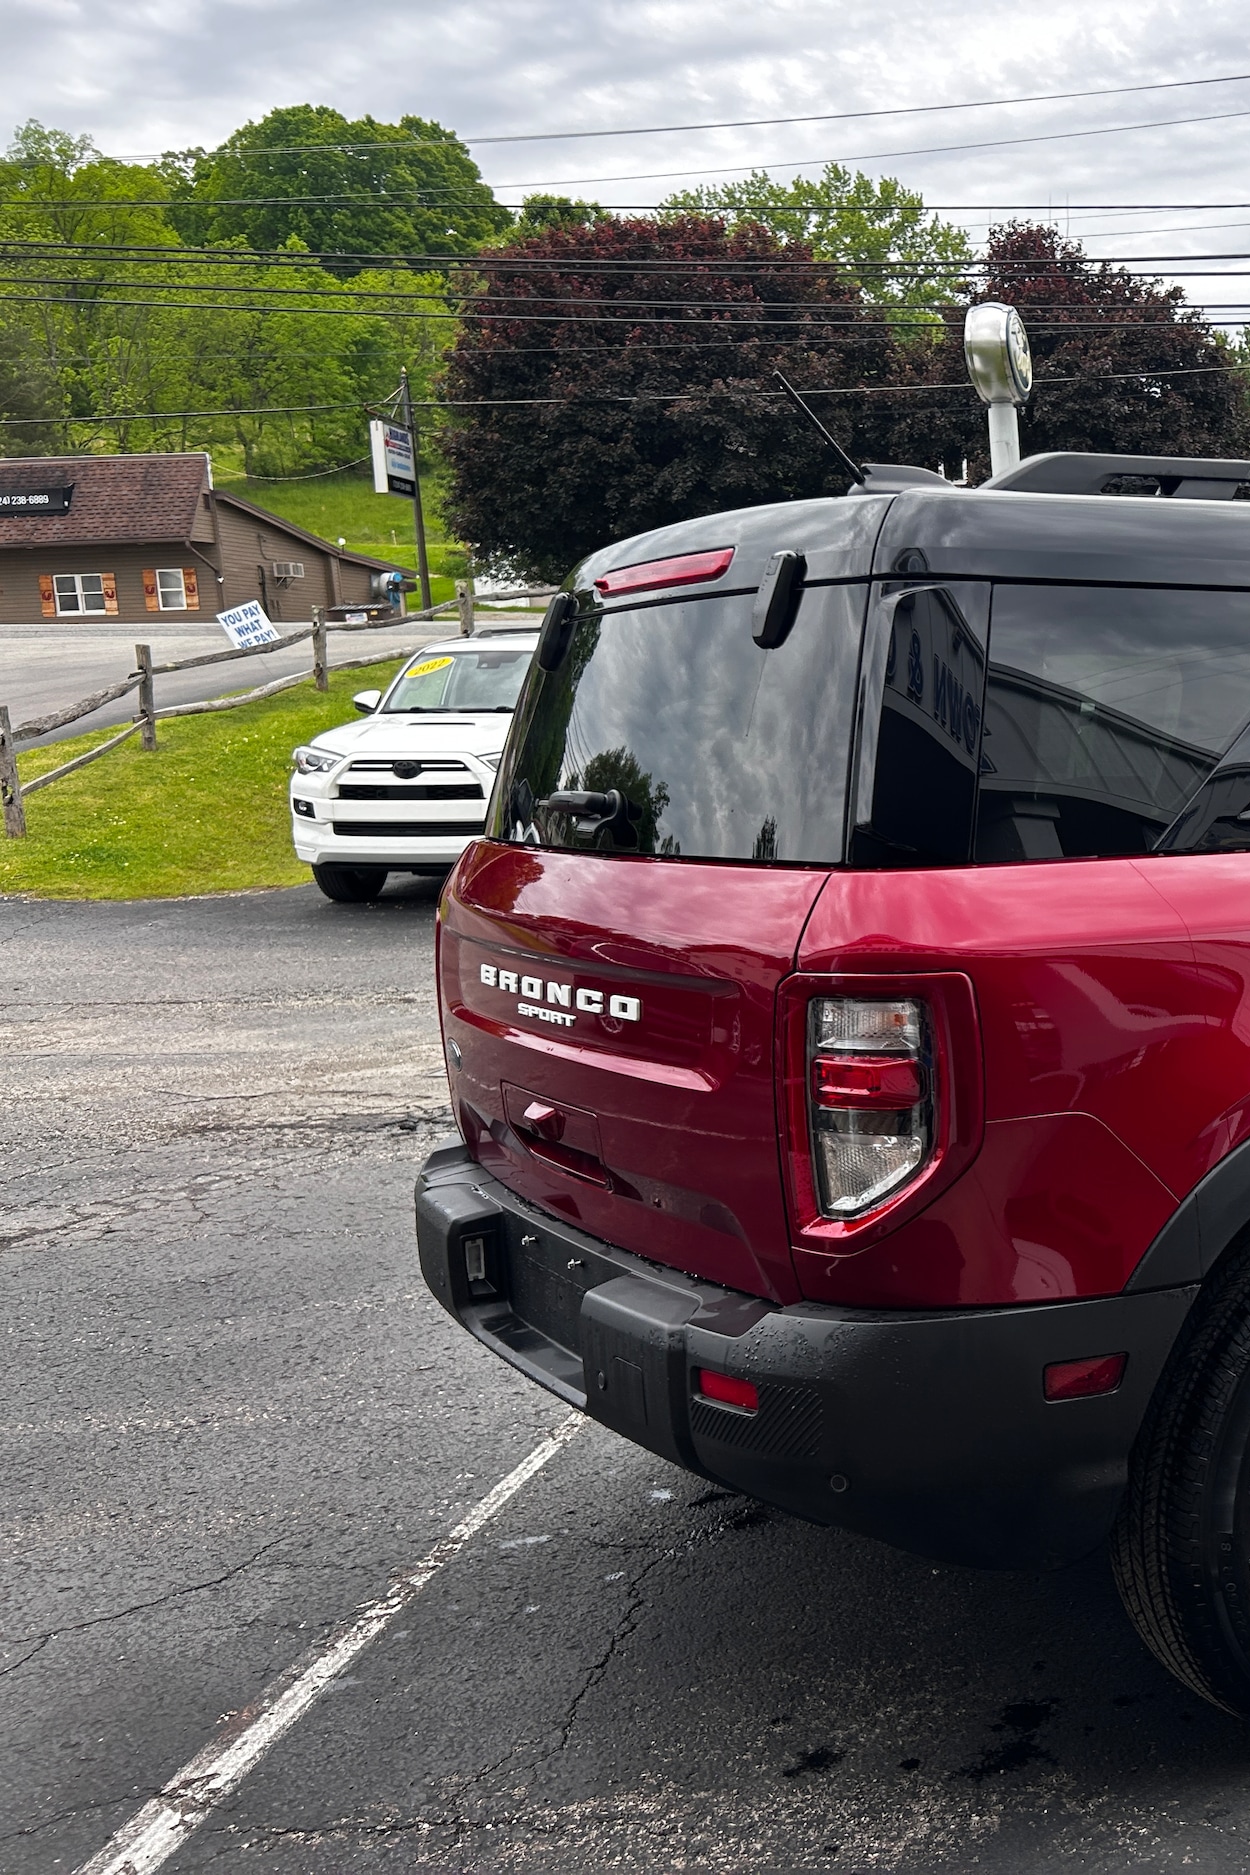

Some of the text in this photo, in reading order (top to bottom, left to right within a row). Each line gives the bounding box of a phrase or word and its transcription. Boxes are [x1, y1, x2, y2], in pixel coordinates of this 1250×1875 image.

[11, 494, 49, 505] 238-6889
[221, 604, 261, 627] YOU PAY
[234, 619, 263, 638] WHAT
[237, 629, 277, 649] WE PAY!
[480, 963, 641, 1022] BRONCO
[517, 1002, 577, 1027] SPORT
